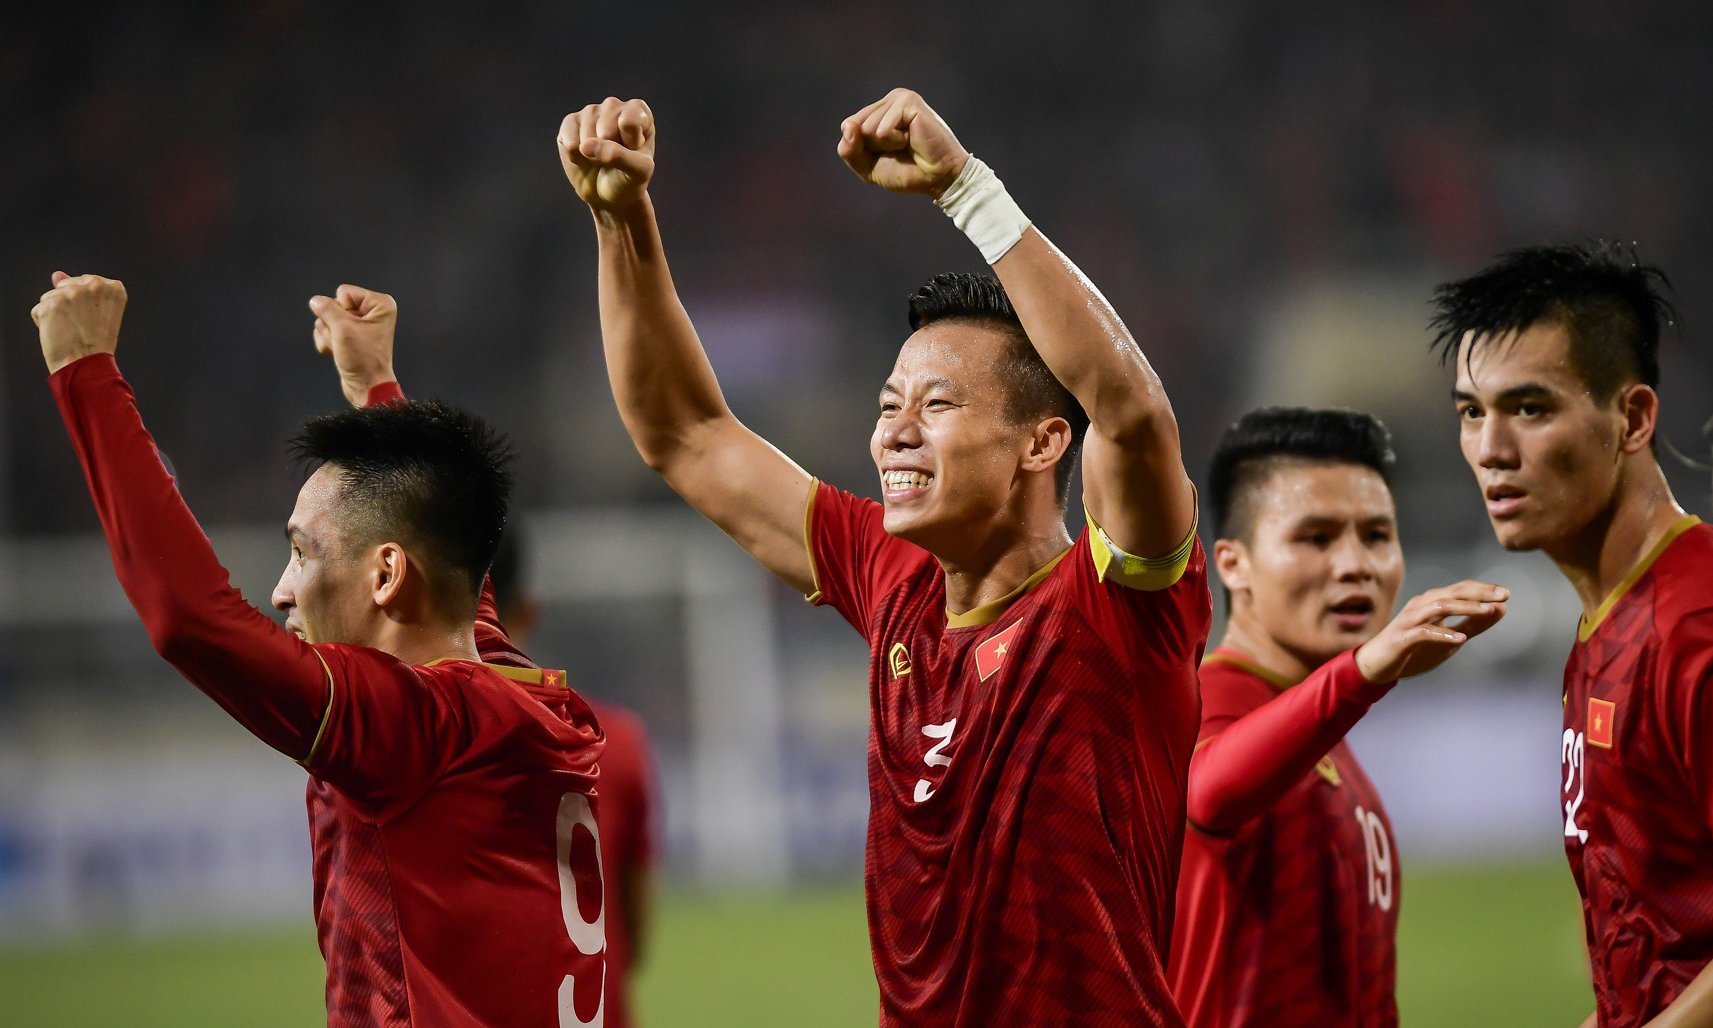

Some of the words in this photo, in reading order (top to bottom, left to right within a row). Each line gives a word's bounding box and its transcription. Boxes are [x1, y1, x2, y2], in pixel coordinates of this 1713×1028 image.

[913, 718, 957, 803] 3
[1562, 728, 1589, 844] 22
[556, 792, 606, 1028] 9
[1355, 805, 1392, 911] 19
